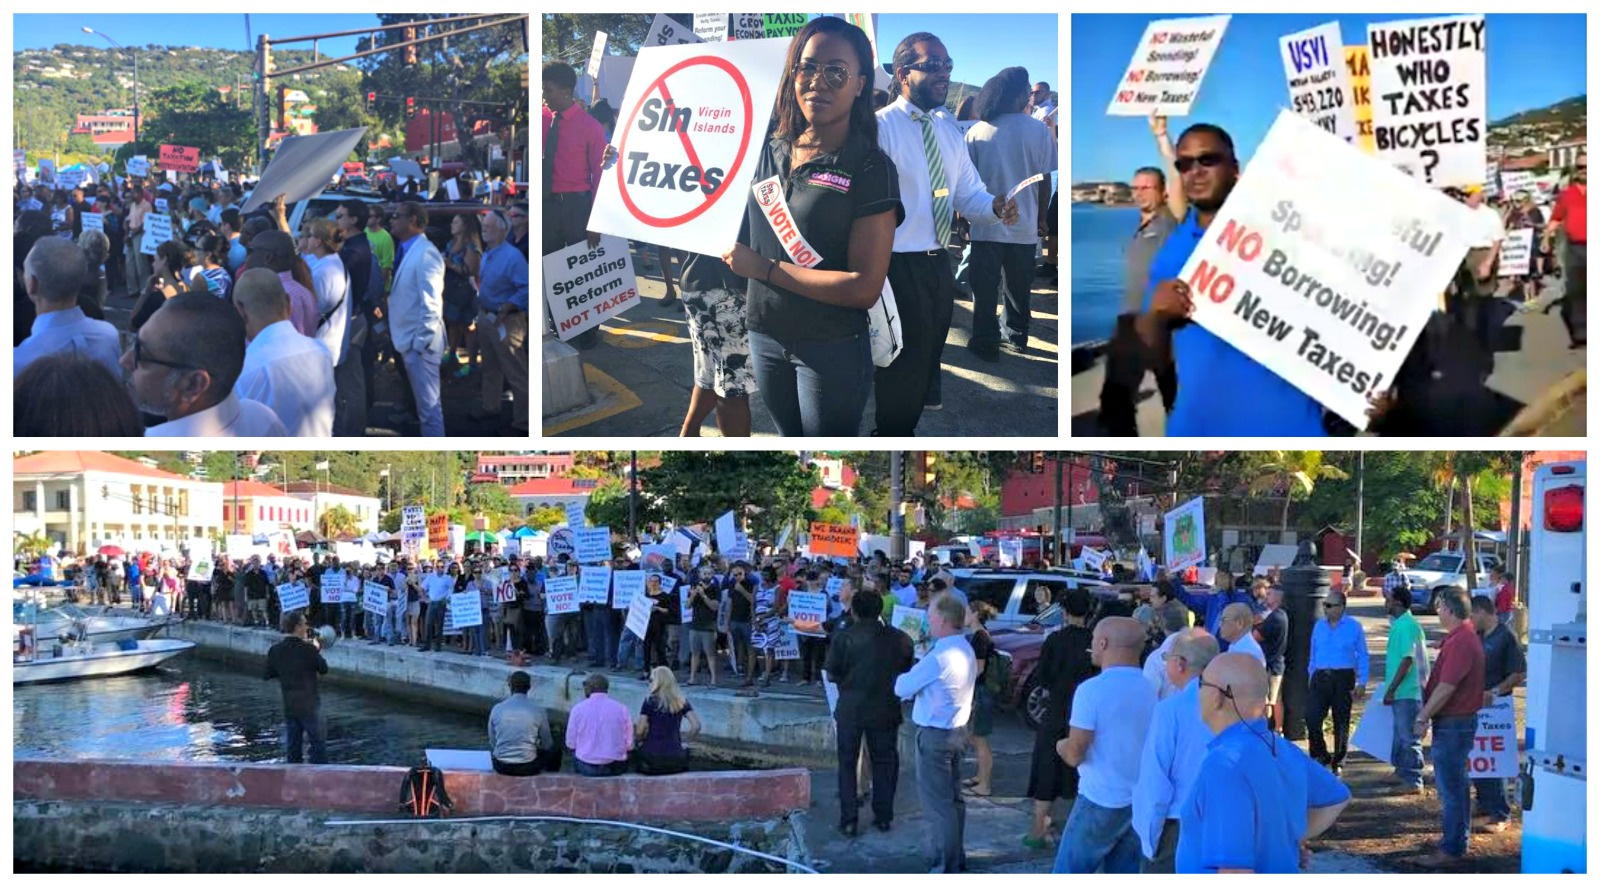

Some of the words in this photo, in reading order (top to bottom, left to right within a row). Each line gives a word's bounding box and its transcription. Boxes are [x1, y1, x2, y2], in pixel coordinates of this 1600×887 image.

[714, 25, 727, 33] your
[766, 13, 805, 24] TAXIS
[767, 27, 784, 38] PAY
[1150, 32, 1168, 44] NO
[1169, 29, 1216, 44] Wasteful
[1147, 48, 1200, 63] Spending!
[1288, 35, 1329, 73] USVI
[1127, 70, 1145, 83] NO
[1145, 68, 1203, 84] Borrowing!
[1396, 59, 1450, 86] WHO
[1116, 90, 1134, 103] NO
[1135, 91, 1158, 103] New
[1160, 90, 1194, 103] Taxes!
[1382, 83, 1470, 115] TAXES
[637, 97, 693, 133] Sin
[698, 106, 731, 120] Virgin
[693, 121, 736, 134] Islands
[1375, 118, 1480, 150] BICYCLES
[627, 150, 725, 195] Taxes
[1420, 149, 1440, 184] ?
[768, 202, 797, 244] VOTE
[566, 246, 606, 270] Pass
[552, 257, 626, 296] Spending
[1216, 218, 1263, 262] NO
[1262, 249, 1408, 351] Borrowing!
[565, 277, 622, 310] Reform
[560, 309, 590, 333] NOT
[593, 288, 636, 315] TAXES
[1188, 260, 1236, 304] NO
[1233, 290, 1294, 342] New
[1296, 326, 1384, 399] Taxes!
[497, 580, 515, 601] NO
[550, 593, 574, 602] VOTE
[793, 611, 821, 621] VOTE
[1481, 722, 1512, 730] Taxes
[1475, 736, 1505, 752] TE
